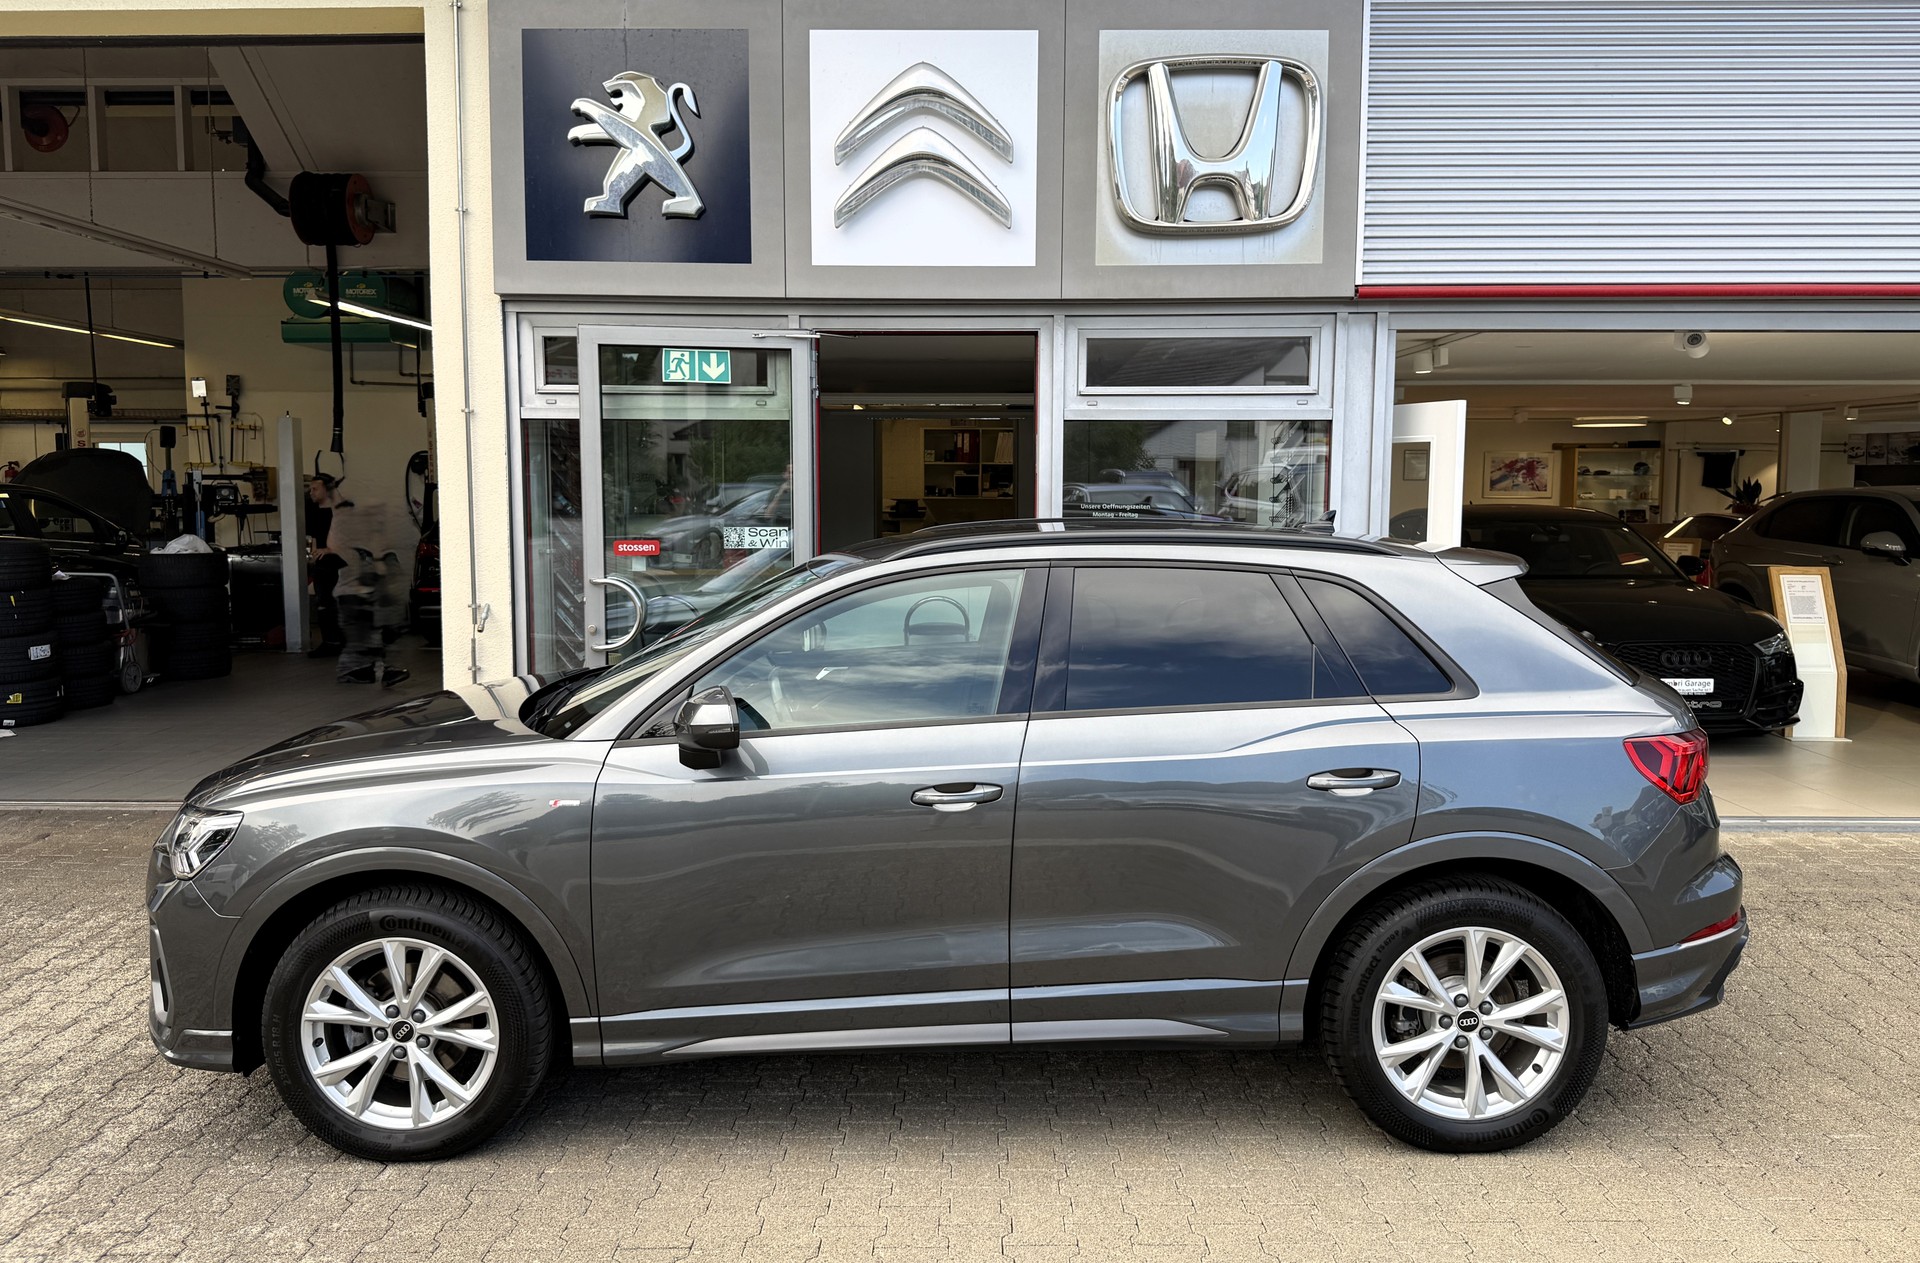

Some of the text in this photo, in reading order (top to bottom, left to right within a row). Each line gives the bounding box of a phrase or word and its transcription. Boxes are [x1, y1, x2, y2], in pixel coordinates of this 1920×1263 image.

[1102, 503, 1151, 511] Oeffnungszeiten
[1092, 511, 1115, 519] Montag
[1118, 511, 1139, 519] Freitag
[748, 527, 788, 537] Scan
[618, 543, 655, 552] stossen
[748, 538, 788, 548] & Win
[1684, 680, 1711, 688] Garage
[380, 914, 471, 951] Continental
[1460, 1108, 1550, 1142] Continental
